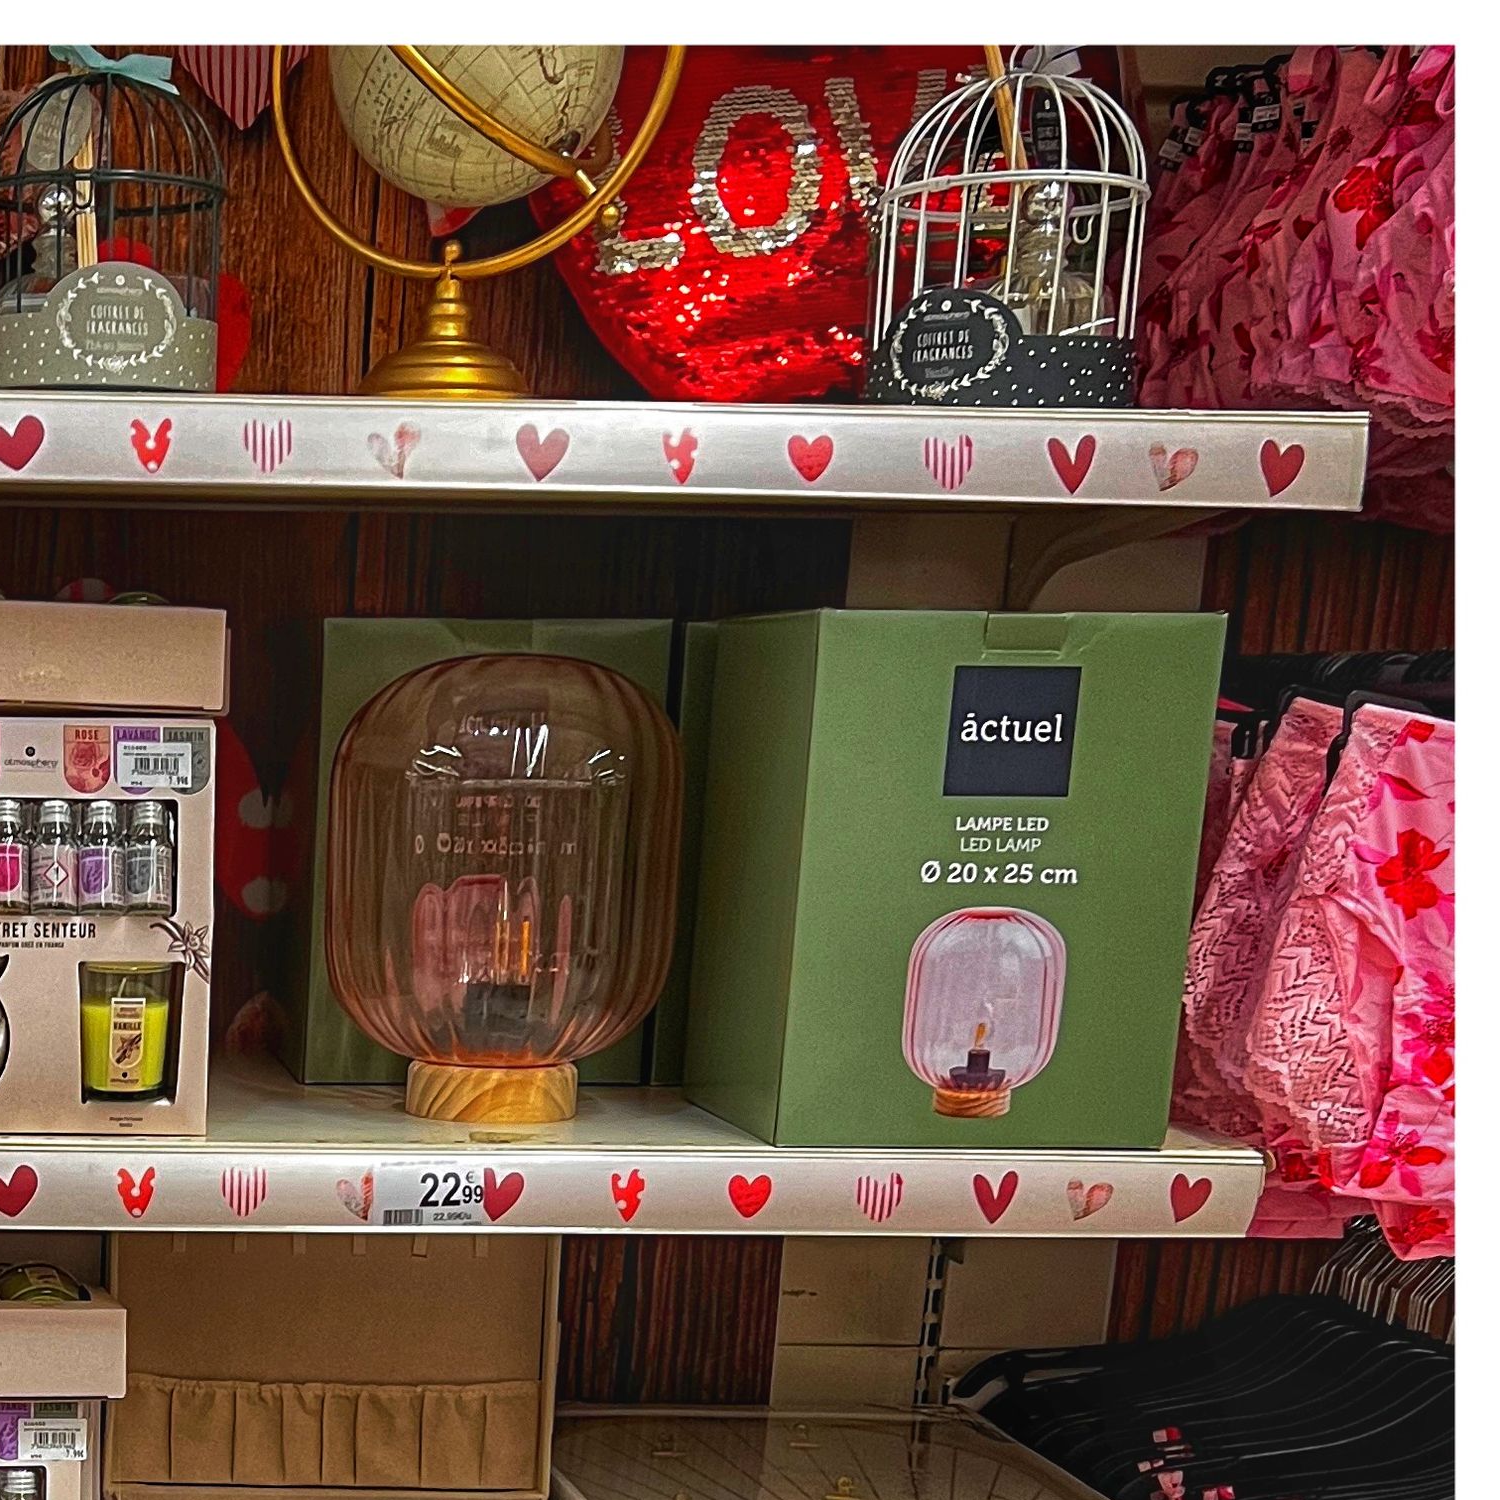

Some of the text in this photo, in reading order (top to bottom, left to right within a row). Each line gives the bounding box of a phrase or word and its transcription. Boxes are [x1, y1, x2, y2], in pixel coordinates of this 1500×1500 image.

[912, 345, 973, 363] FRAGRANCES
[75, 729, 100, 741] ROSE
[117, 729, 157, 741] LAVANDE
[955, 816, 1049, 832] LAMPE LED
[960, 837, 1042, 853] LED LAMP
[947, 863, 978, 883] 20
[983, 868, 999, 883] x
[1004, 864, 1033, 883] 25
[1040, 868, 1078, 884] cm
[34, 923, 96, 939] SENTEUR
